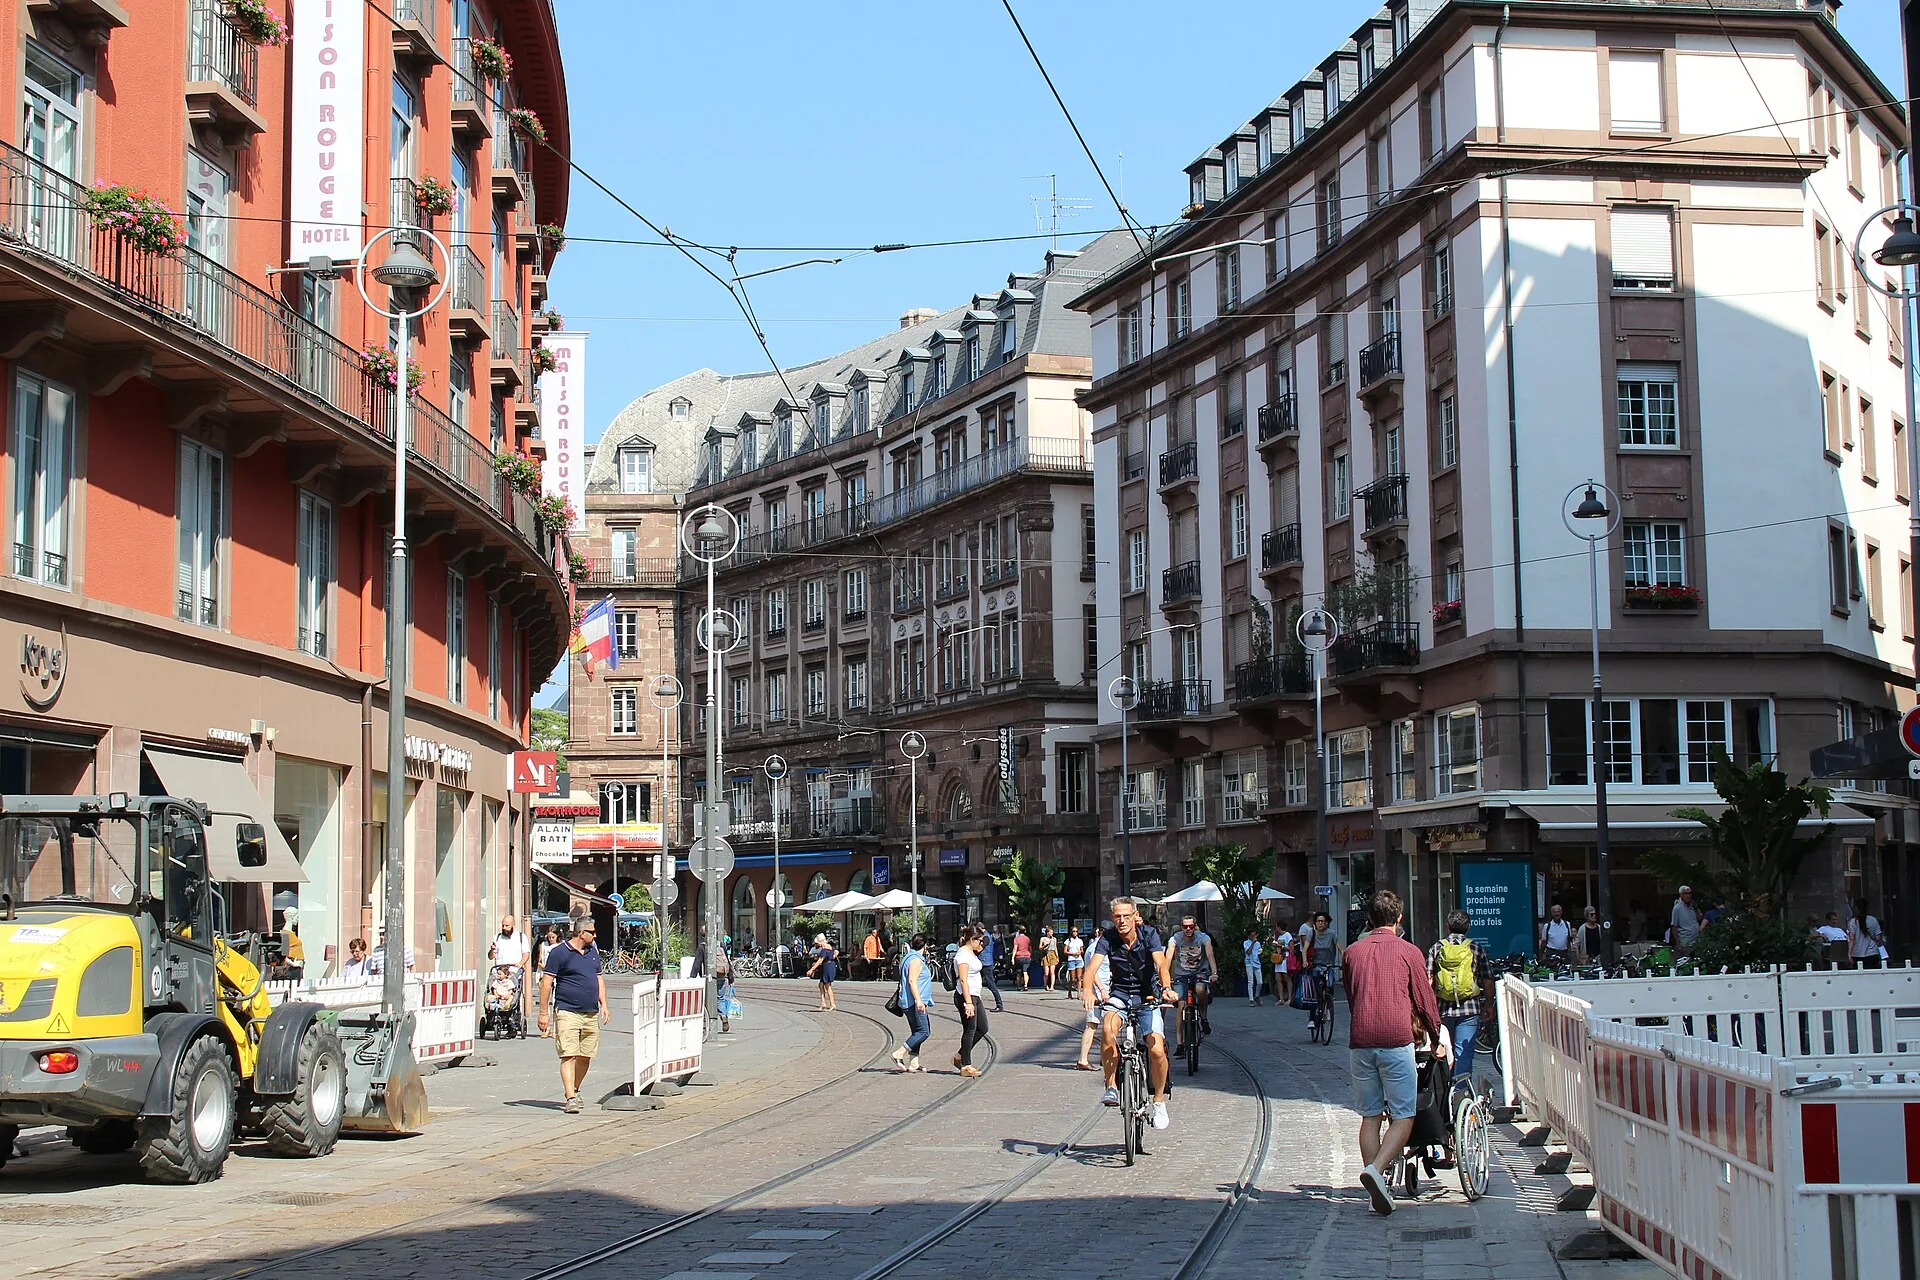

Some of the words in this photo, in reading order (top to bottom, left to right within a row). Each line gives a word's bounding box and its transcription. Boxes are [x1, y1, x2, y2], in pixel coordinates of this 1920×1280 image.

[317, 104, 337, 219] ROUGE
[302, 228, 350, 244] HOTEL
[556, 347, 571, 430] MAISON
[557, 438, 570, 500] ROUG
[20, 633, 62, 689] Krys
[999, 728, 1009, 779] odyssée
[564, 806, 600, 817] ROUGE
[537, 825, 571, 833] ALAIN
[540, 835, 567, 843] BATT
[993, 846, 1012, 858] odyssée
[873, 869, 888, 879] Café
[875, 876, 887, 884] Bar
[1465, 884, 1473, 893] la
[1474, 884, 1508, 893] semaine
[1466, 895, 1505, 905] prochaine
[1475, 907, 1501, 915] meurs
[1469, 917, 1486, 926] rois
[1487, 917, 1502, 926] fois
[154, 971, 160, 991] 20
